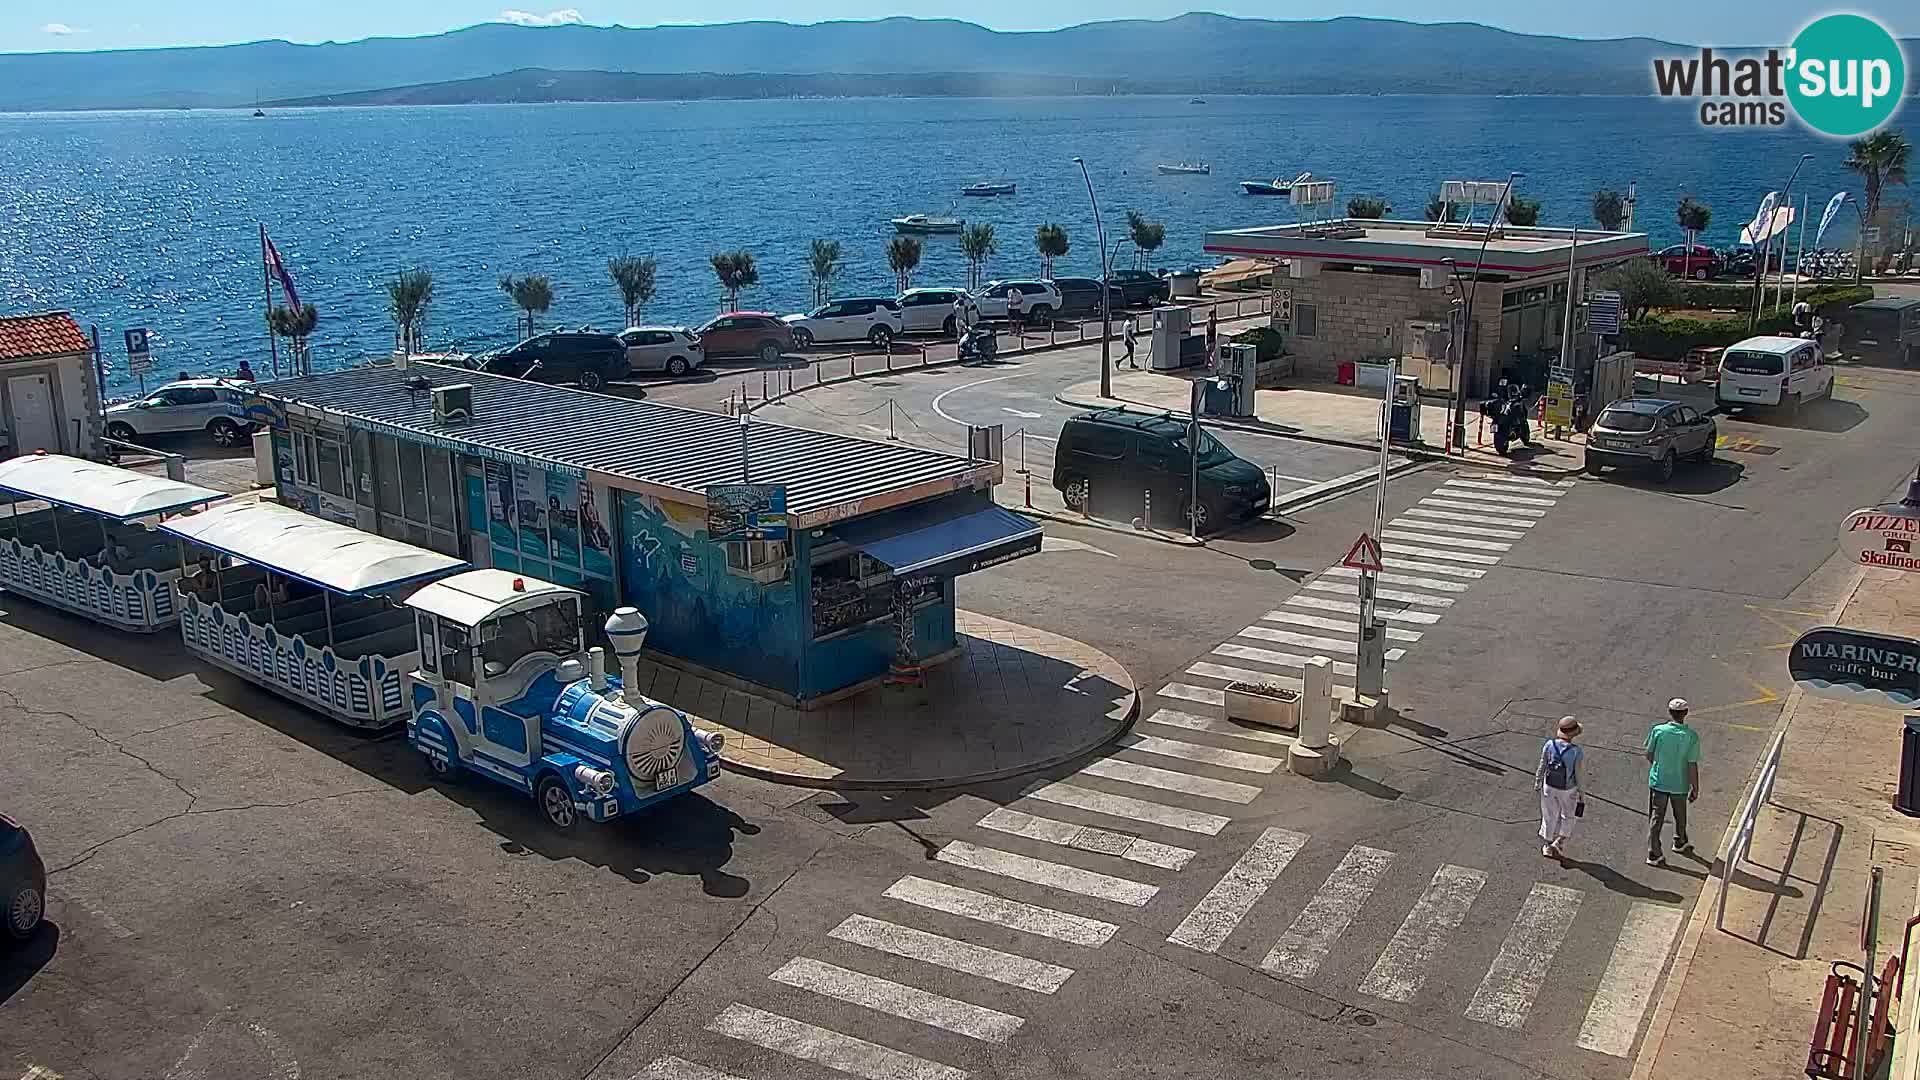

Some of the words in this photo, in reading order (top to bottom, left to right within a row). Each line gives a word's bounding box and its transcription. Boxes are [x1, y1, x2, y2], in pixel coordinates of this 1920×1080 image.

[130, 332, 143, 350] P
[494, 450, 526, 465] STATION
[529, 457, 554, 472] TICKET
[556, 462, 583, 478] OFFICE
[1848, 515, 1920, 533] PIZZE
[1883, 530, 1918, 541] GRILL
[1829, 662, 1866, 676] caffe
[1871, 665, 1898, 680] bar
